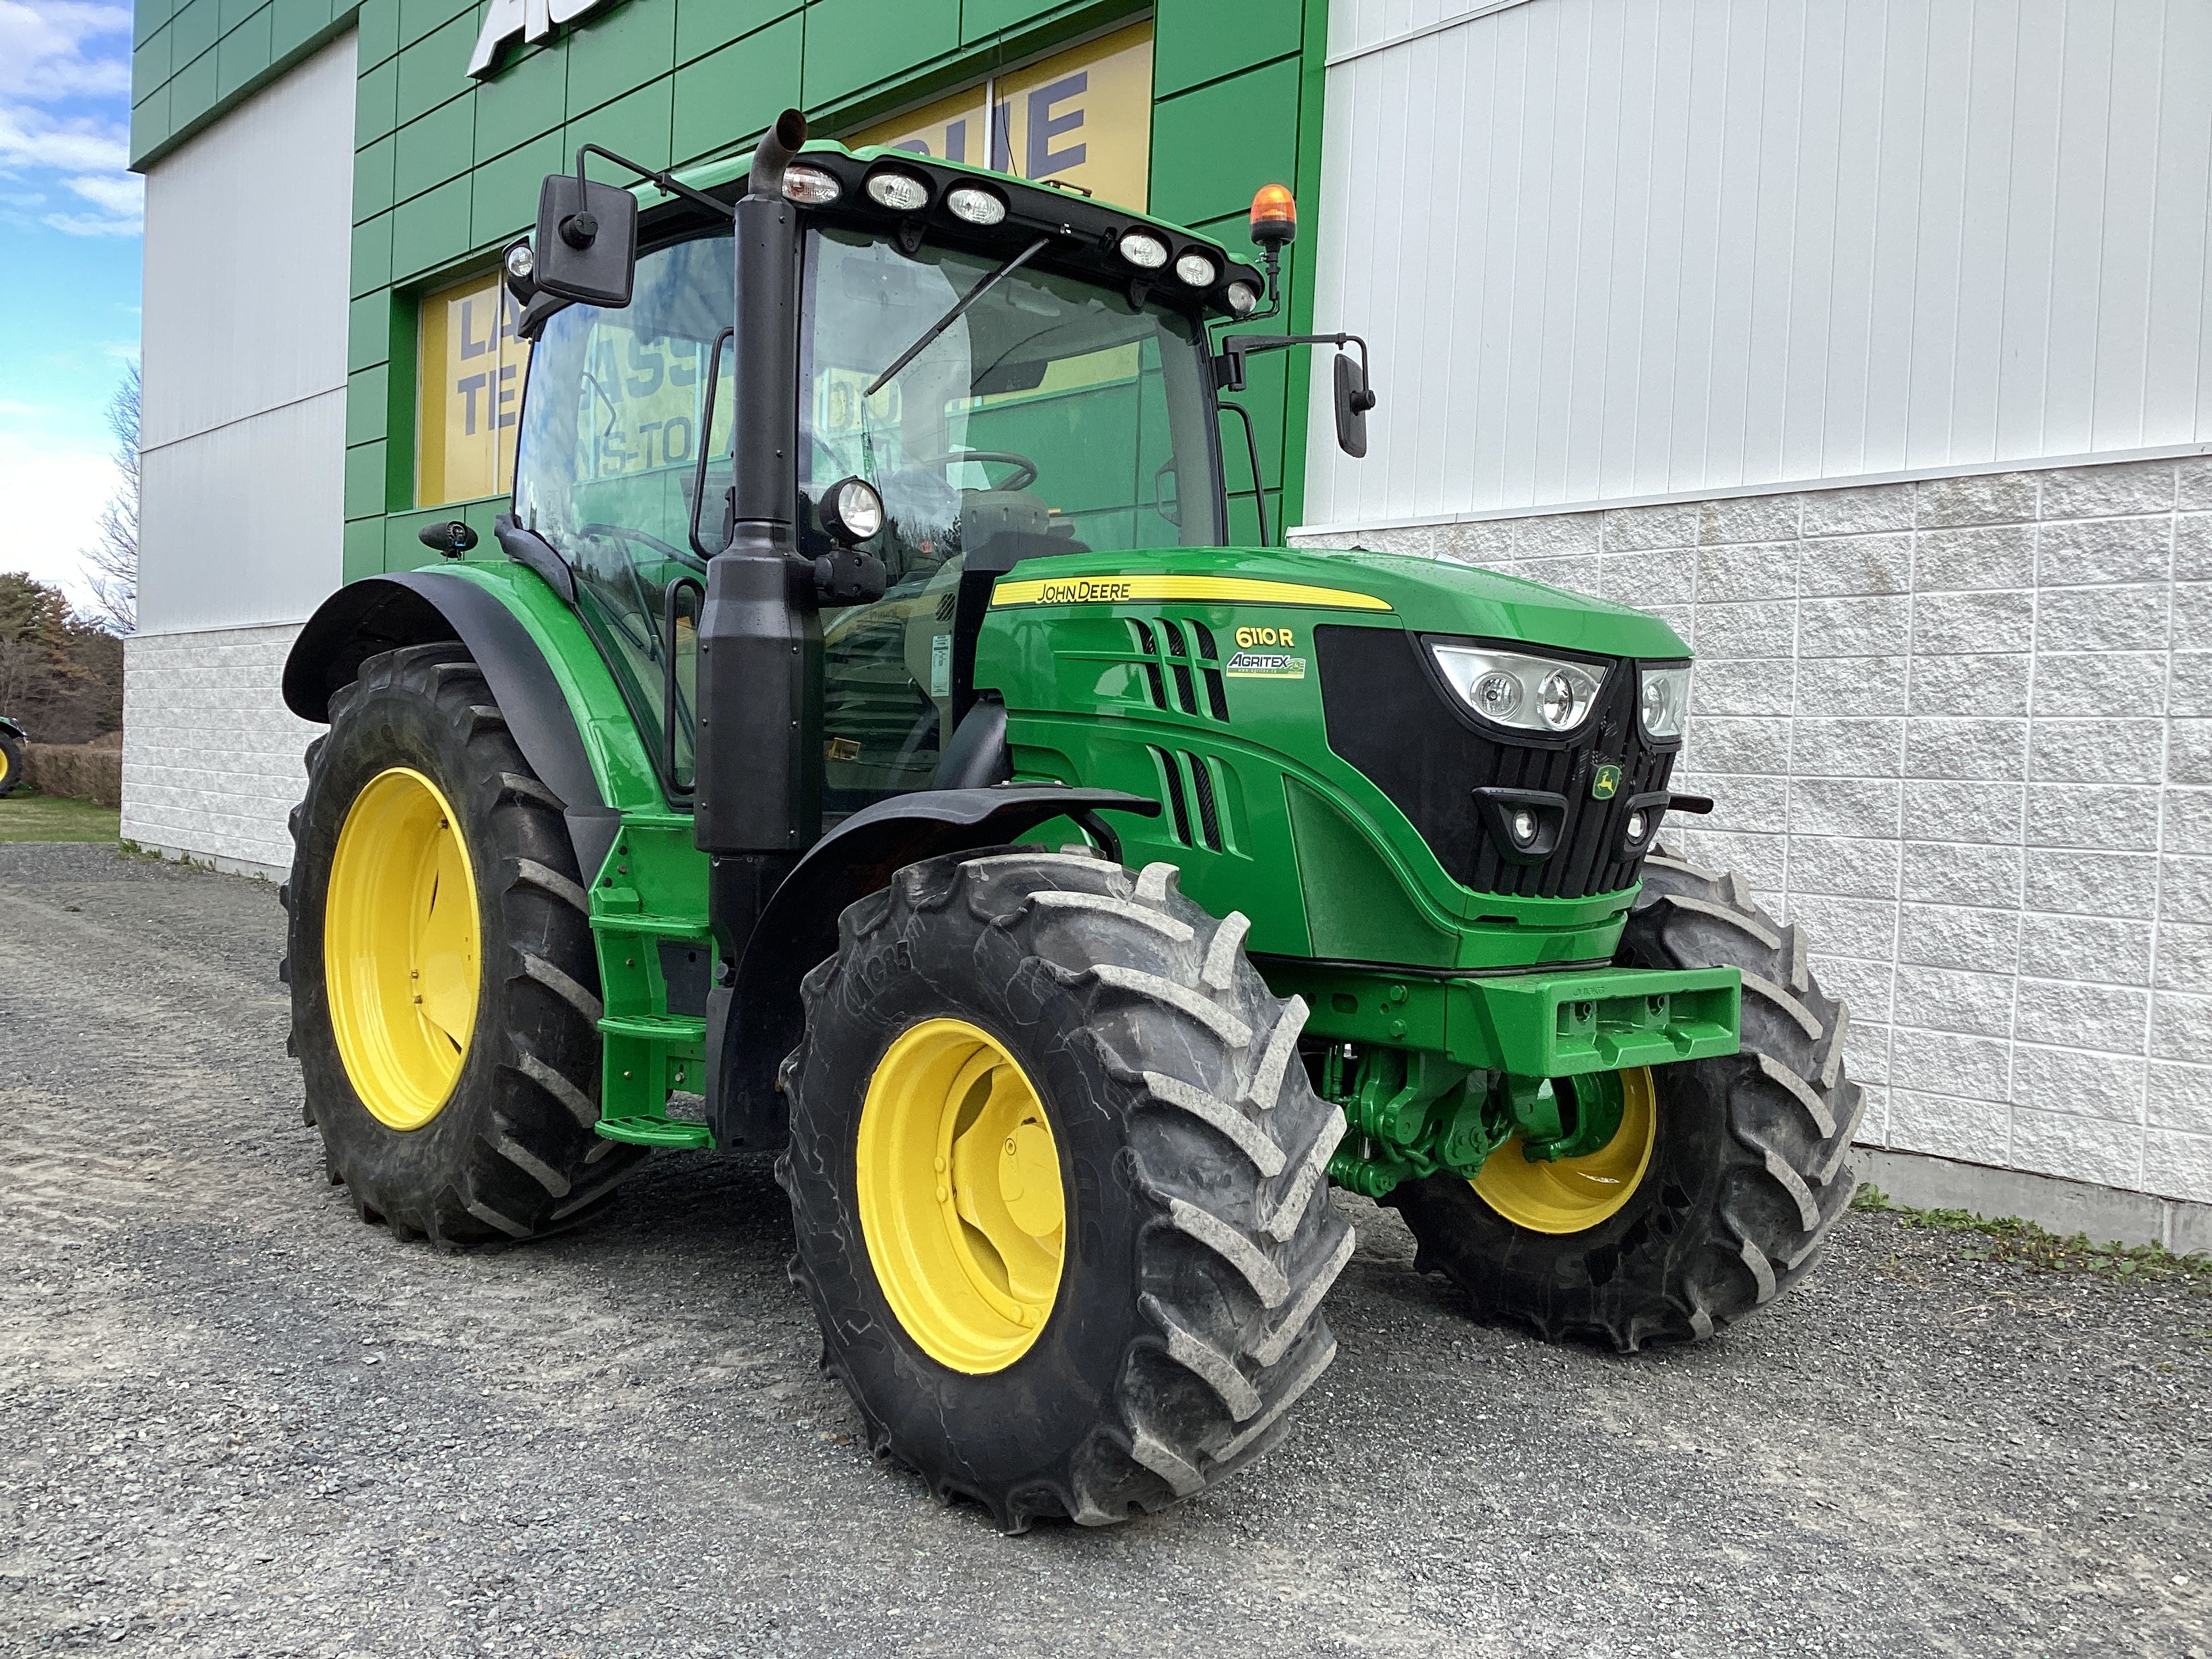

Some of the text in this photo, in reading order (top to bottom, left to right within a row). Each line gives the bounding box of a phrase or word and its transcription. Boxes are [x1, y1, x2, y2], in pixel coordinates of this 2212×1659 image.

[461, 287, 526, 361] LA
[457, 364, 517, 436] TE
[1038, 581, 1131, 601] JOHN DEERE
[1229, 653, 1289, 668] AGRITEX
